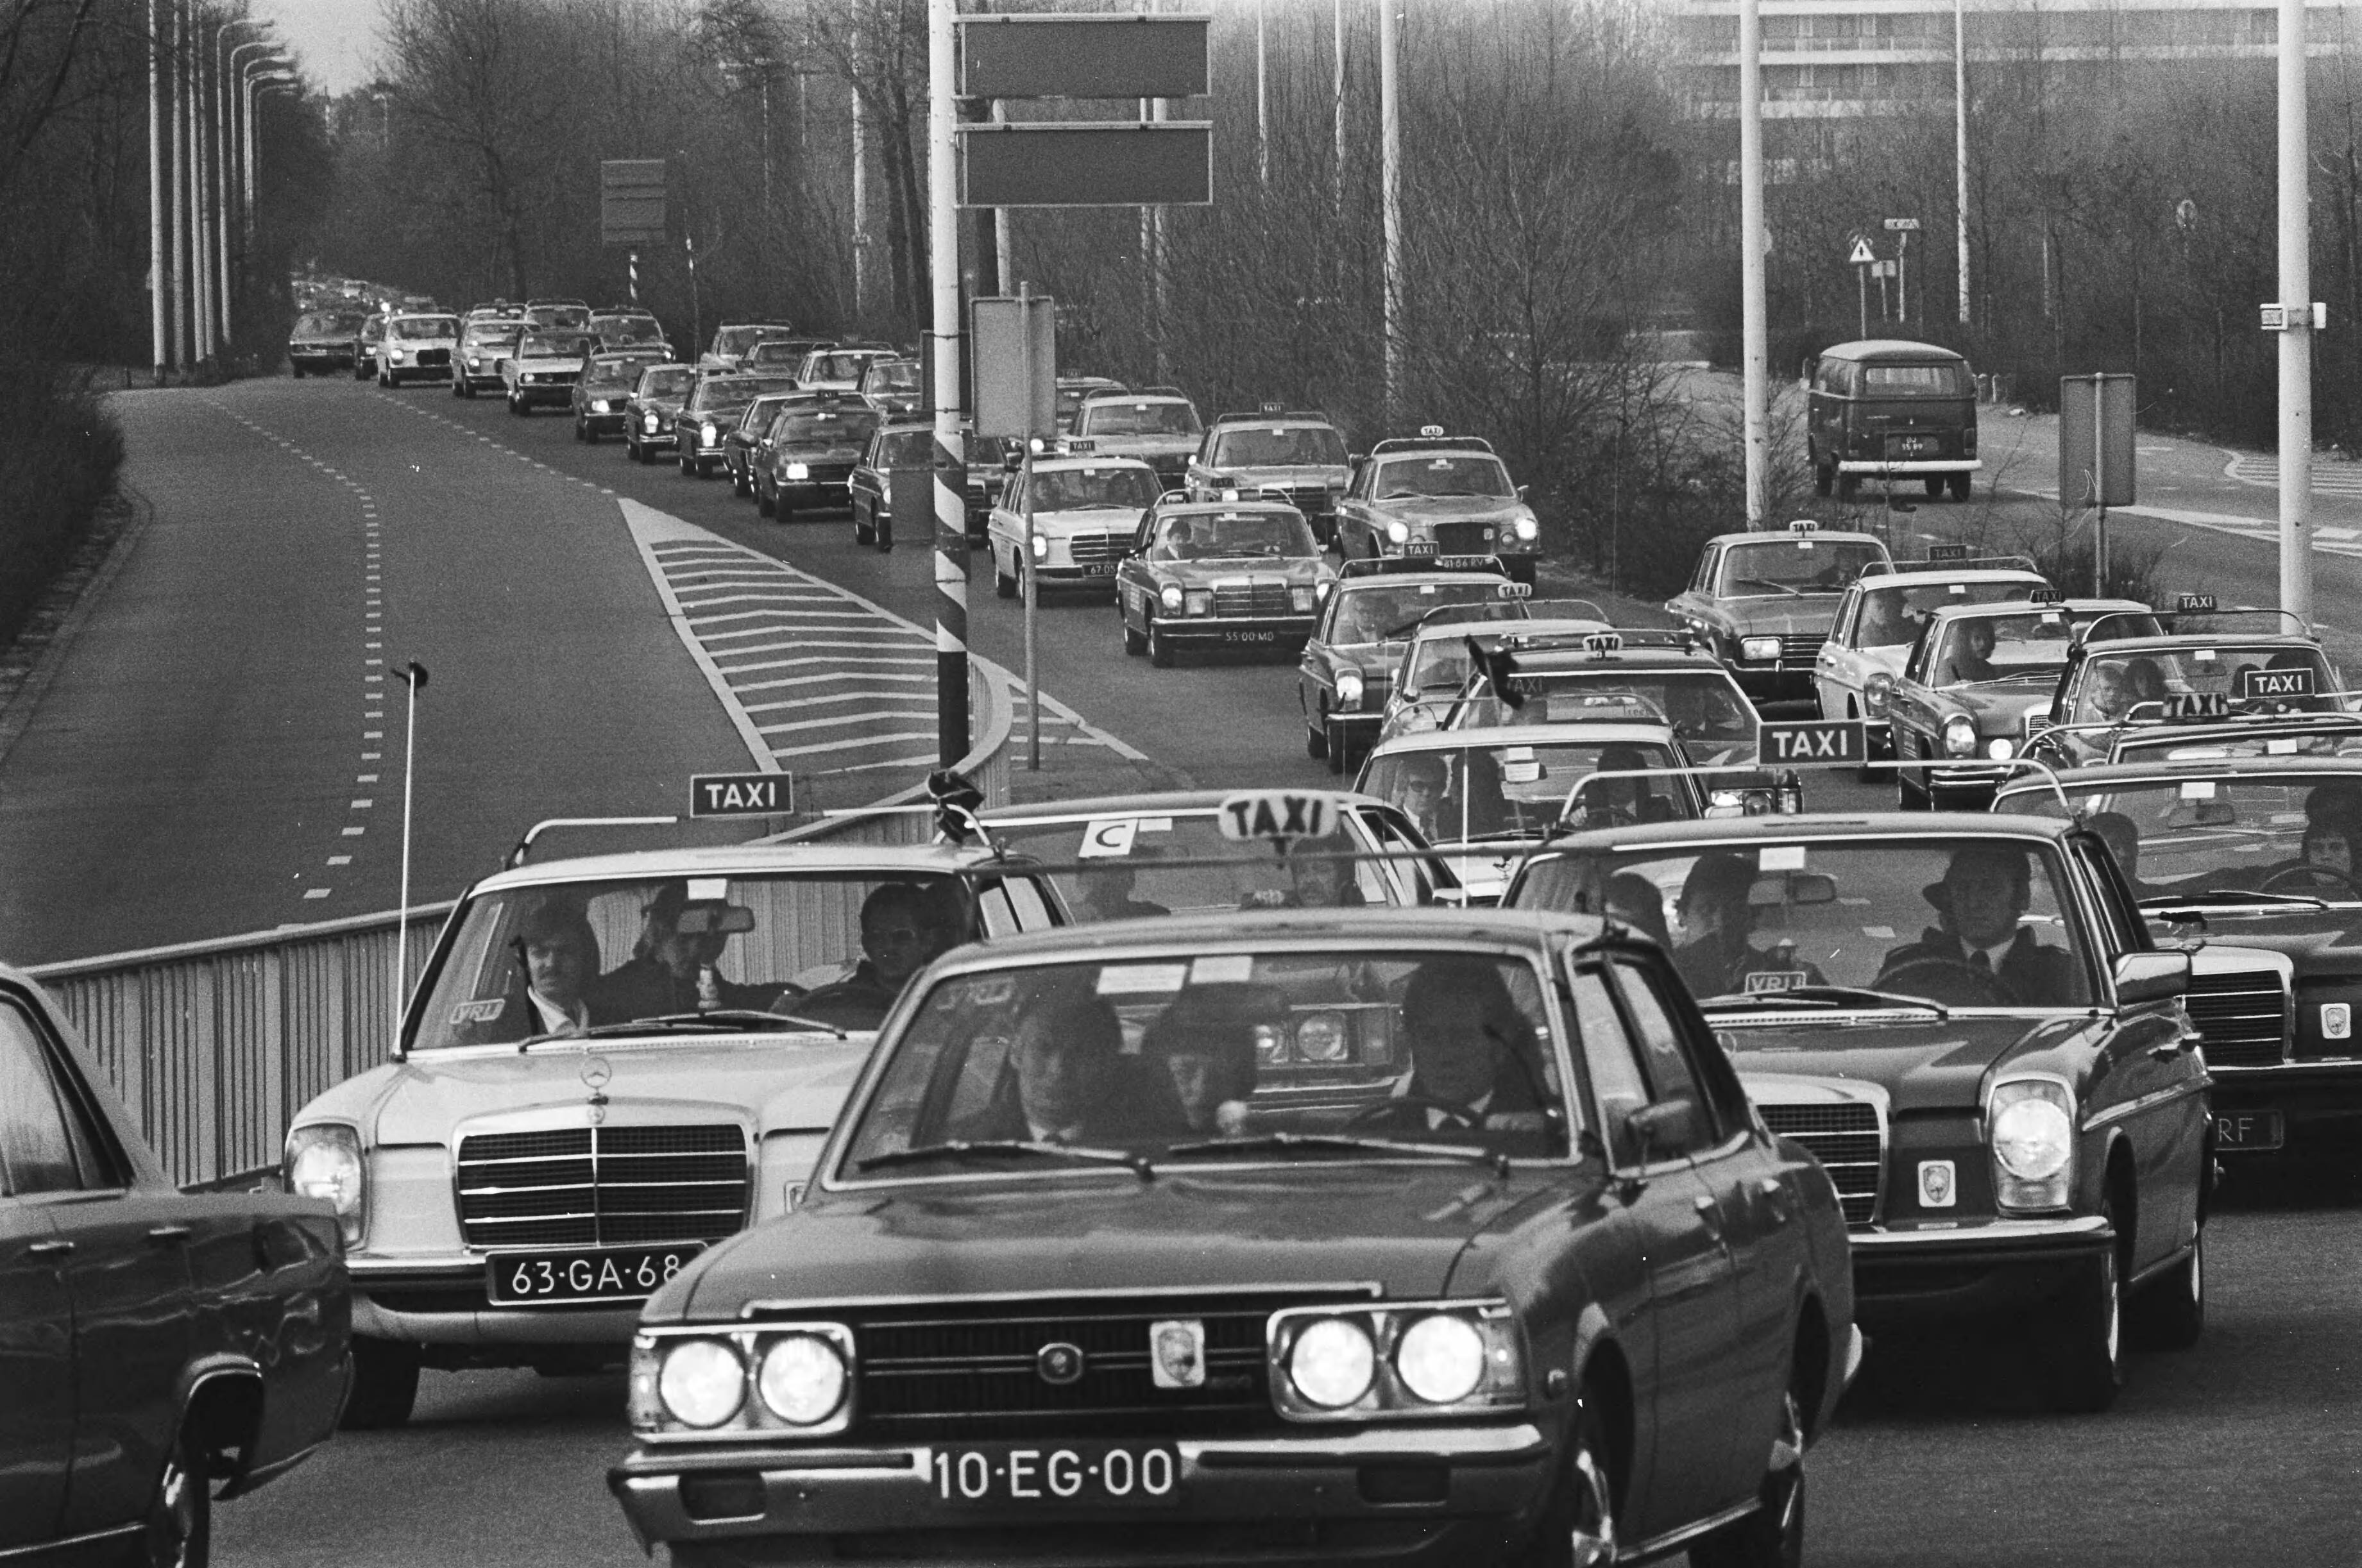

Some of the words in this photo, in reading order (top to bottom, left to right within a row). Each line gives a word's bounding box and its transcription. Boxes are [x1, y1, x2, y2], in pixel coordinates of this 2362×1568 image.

[1793, 523, 1815, 532] TAXI
[1408, 545, 1434, 555] TAXI
[1935, 548, 1961, 558] TAXI
[1501, 584, 1529, 597] TAXI
[2035, 591, 2062, 602] TAXI
[2182, 596, 2213, 609] TAXI
[1586, 636, 1619, 651] TAXI
[2255, 675, 2303, 693] TAXI
[2166, 693, 2225, 718] TAXI
[1772, 729, 1848, 758] TAXI
[705, 781, 776, 809] TAXI
[1227, 795, 1323, 836] TAXI
[1095, 824, 1126, 848] C
